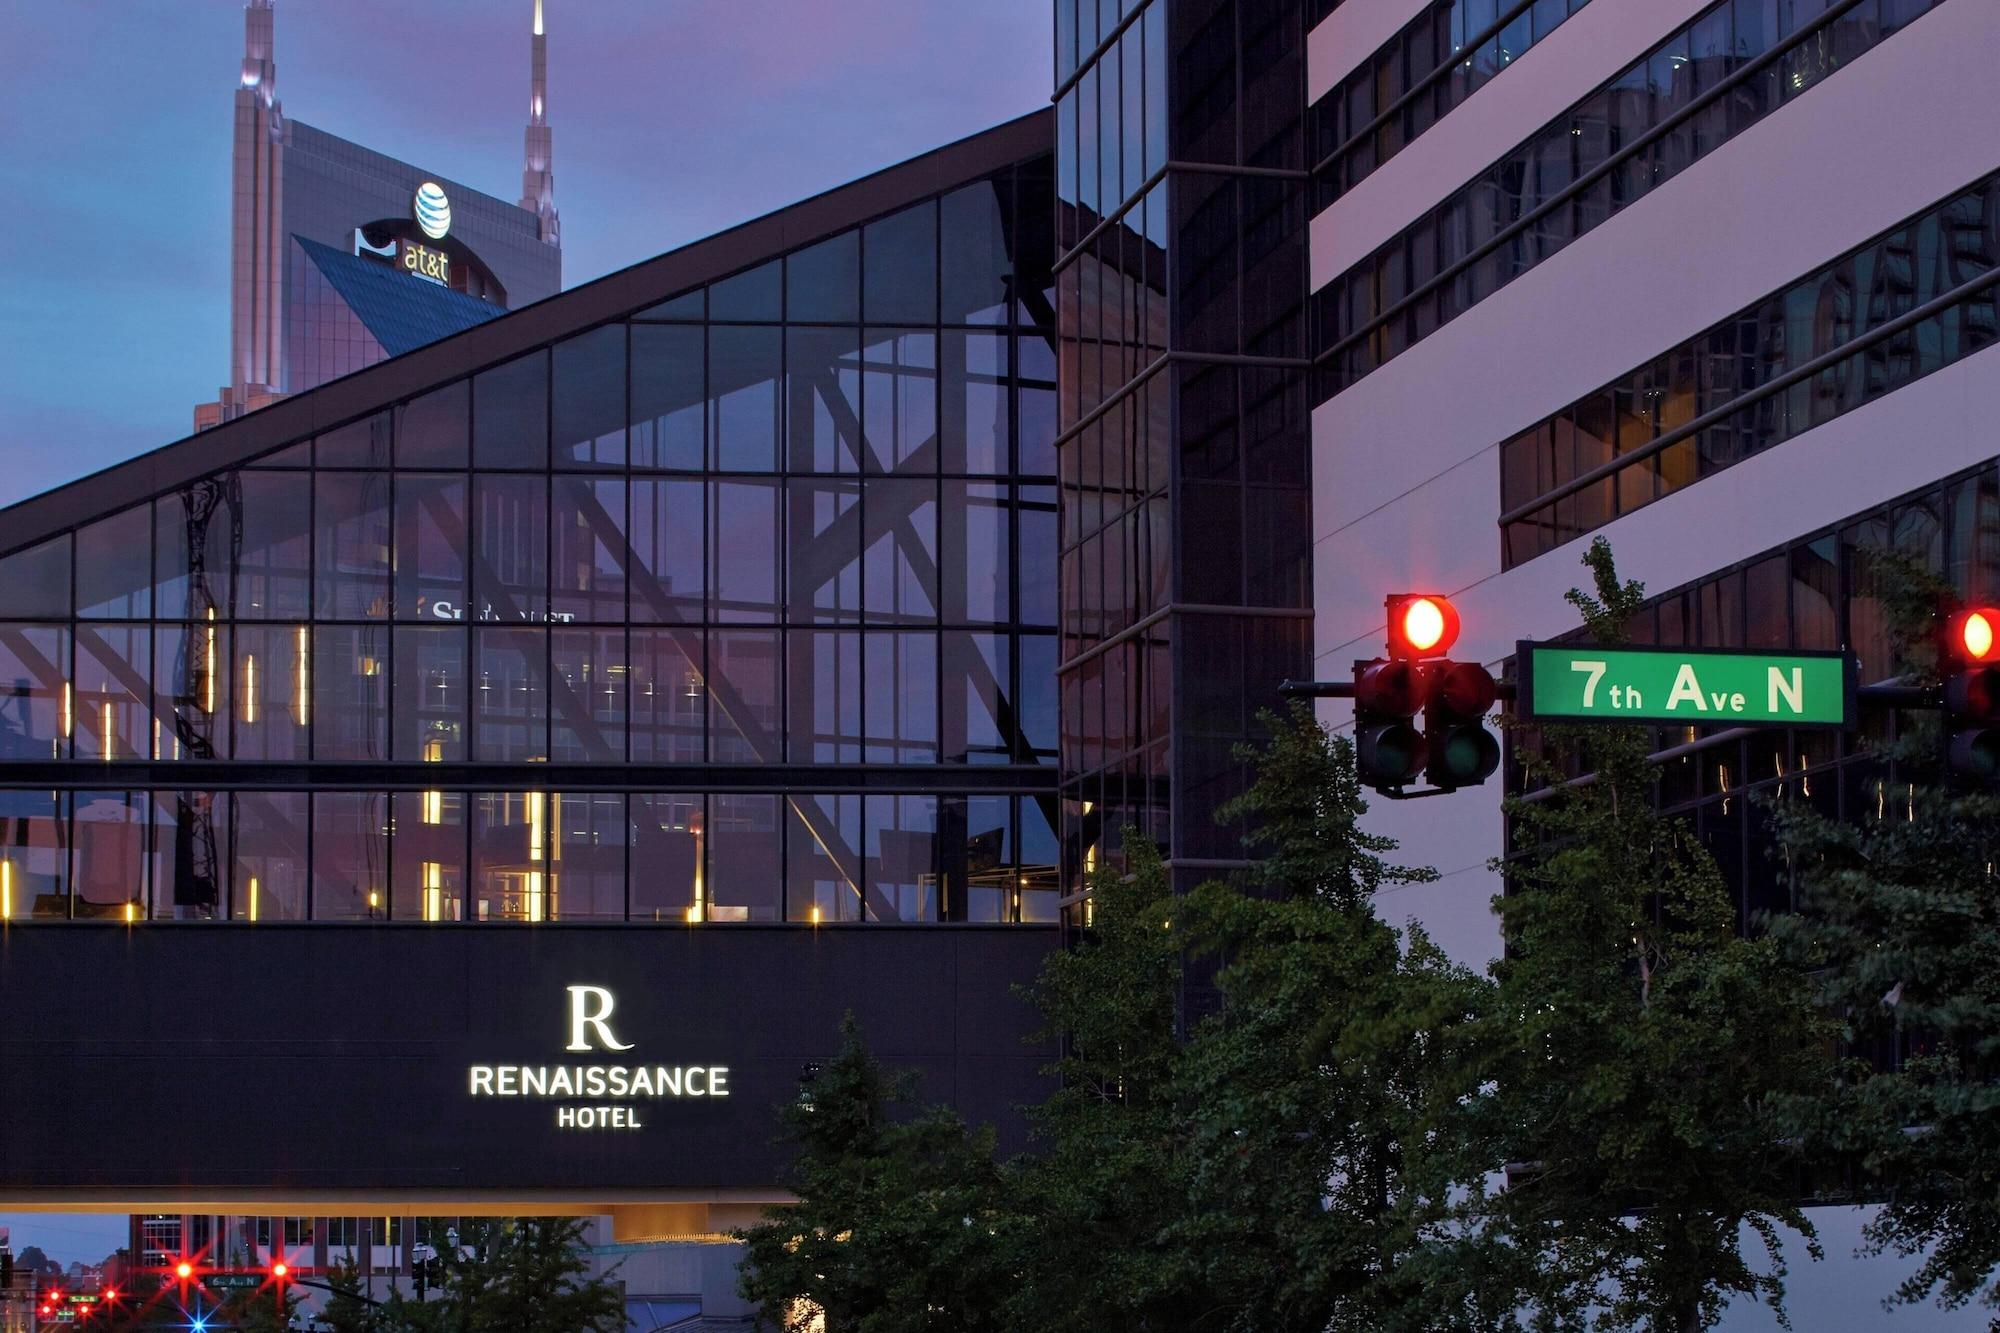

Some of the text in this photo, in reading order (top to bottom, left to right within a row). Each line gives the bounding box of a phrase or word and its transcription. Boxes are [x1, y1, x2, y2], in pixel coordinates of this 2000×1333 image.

[405, 245, 448, 282] at&t
[1571, 660, 1803, 714] 7th Ave N
[566, 985, 635, 1051] R
[470, 1066, 730, 1096] RENAISSANCE
[558, 1106, 642, 1129] HOTEL
